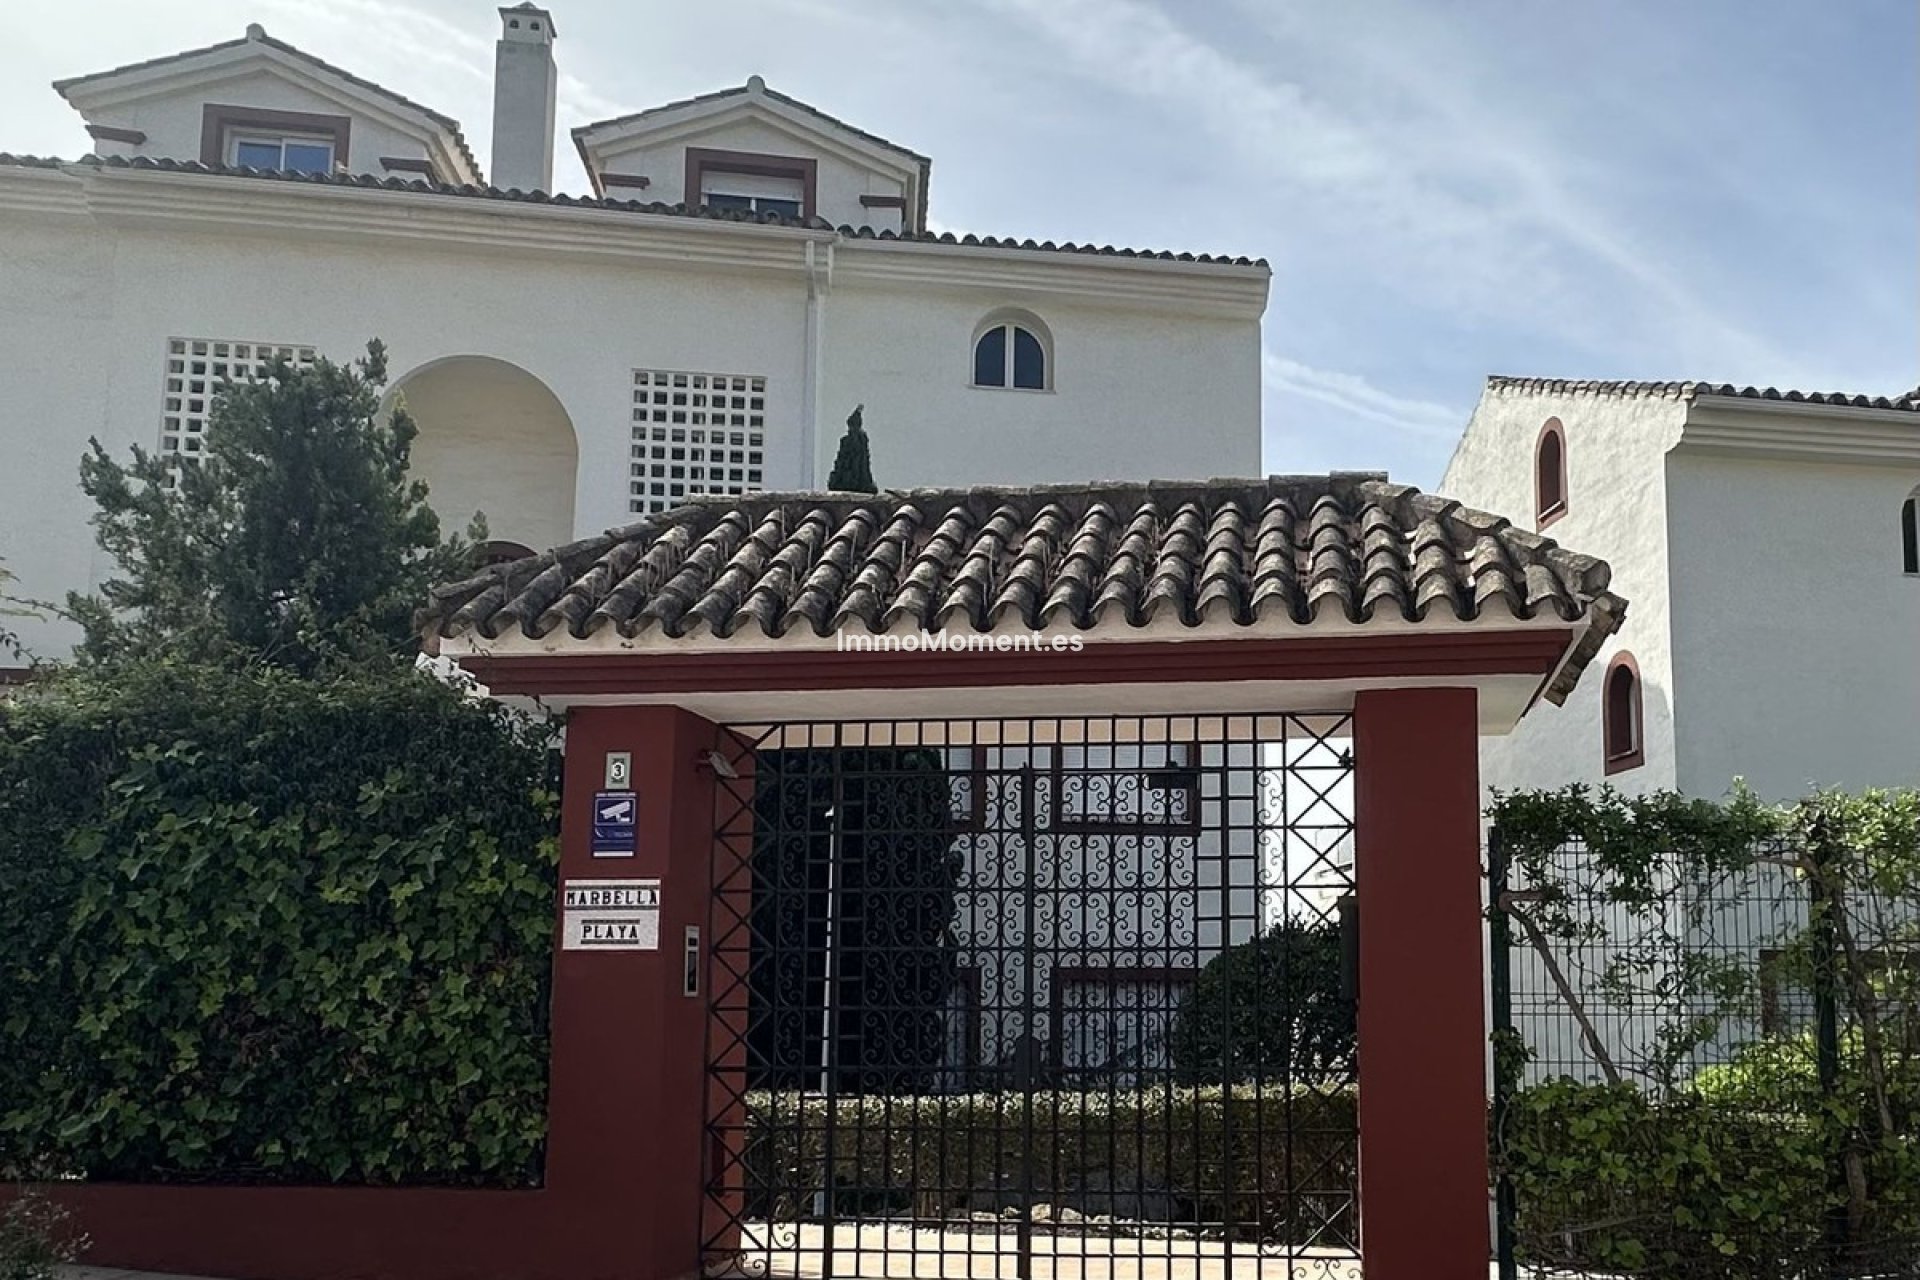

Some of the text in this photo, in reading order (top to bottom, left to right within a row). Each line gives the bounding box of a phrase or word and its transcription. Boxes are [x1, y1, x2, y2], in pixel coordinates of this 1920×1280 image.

[613, 764, 622, 777] 3
[566, 890, 658, 905] MARBELLA
[583, 925, 638, 939] PLAYA
